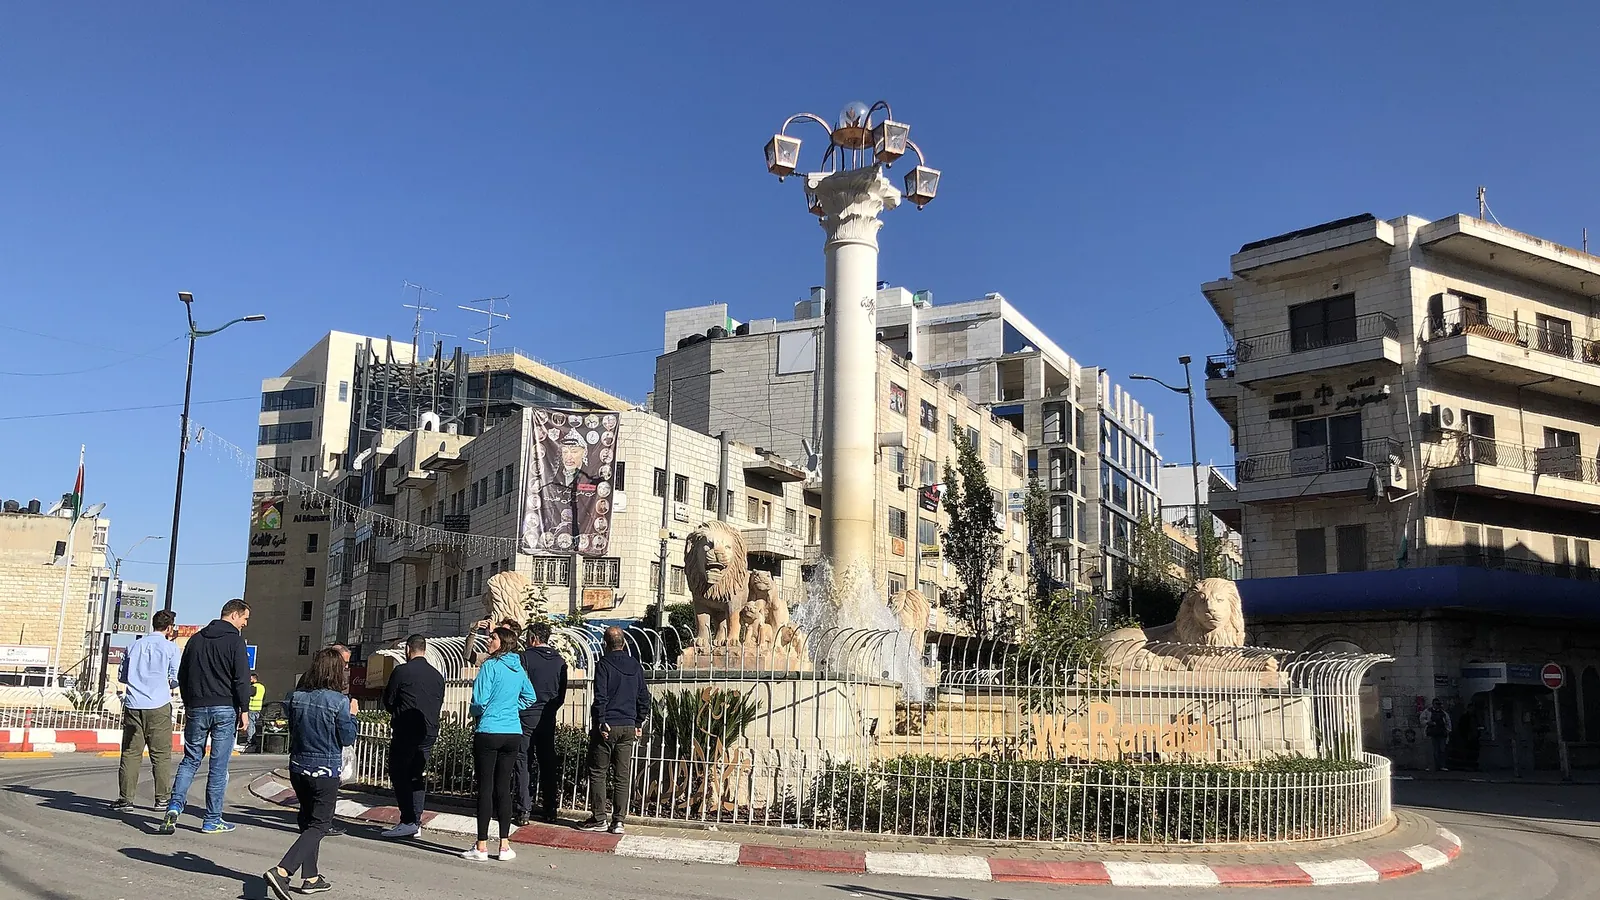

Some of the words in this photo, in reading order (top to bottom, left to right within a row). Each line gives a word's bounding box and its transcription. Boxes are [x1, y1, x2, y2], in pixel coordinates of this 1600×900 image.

[293, 514, 302, 522] Al
[302, 514, 330, 522] Manara
[1032, 714, 1083, 753] We
[1089, 702, 1215, 753] Ramallah
